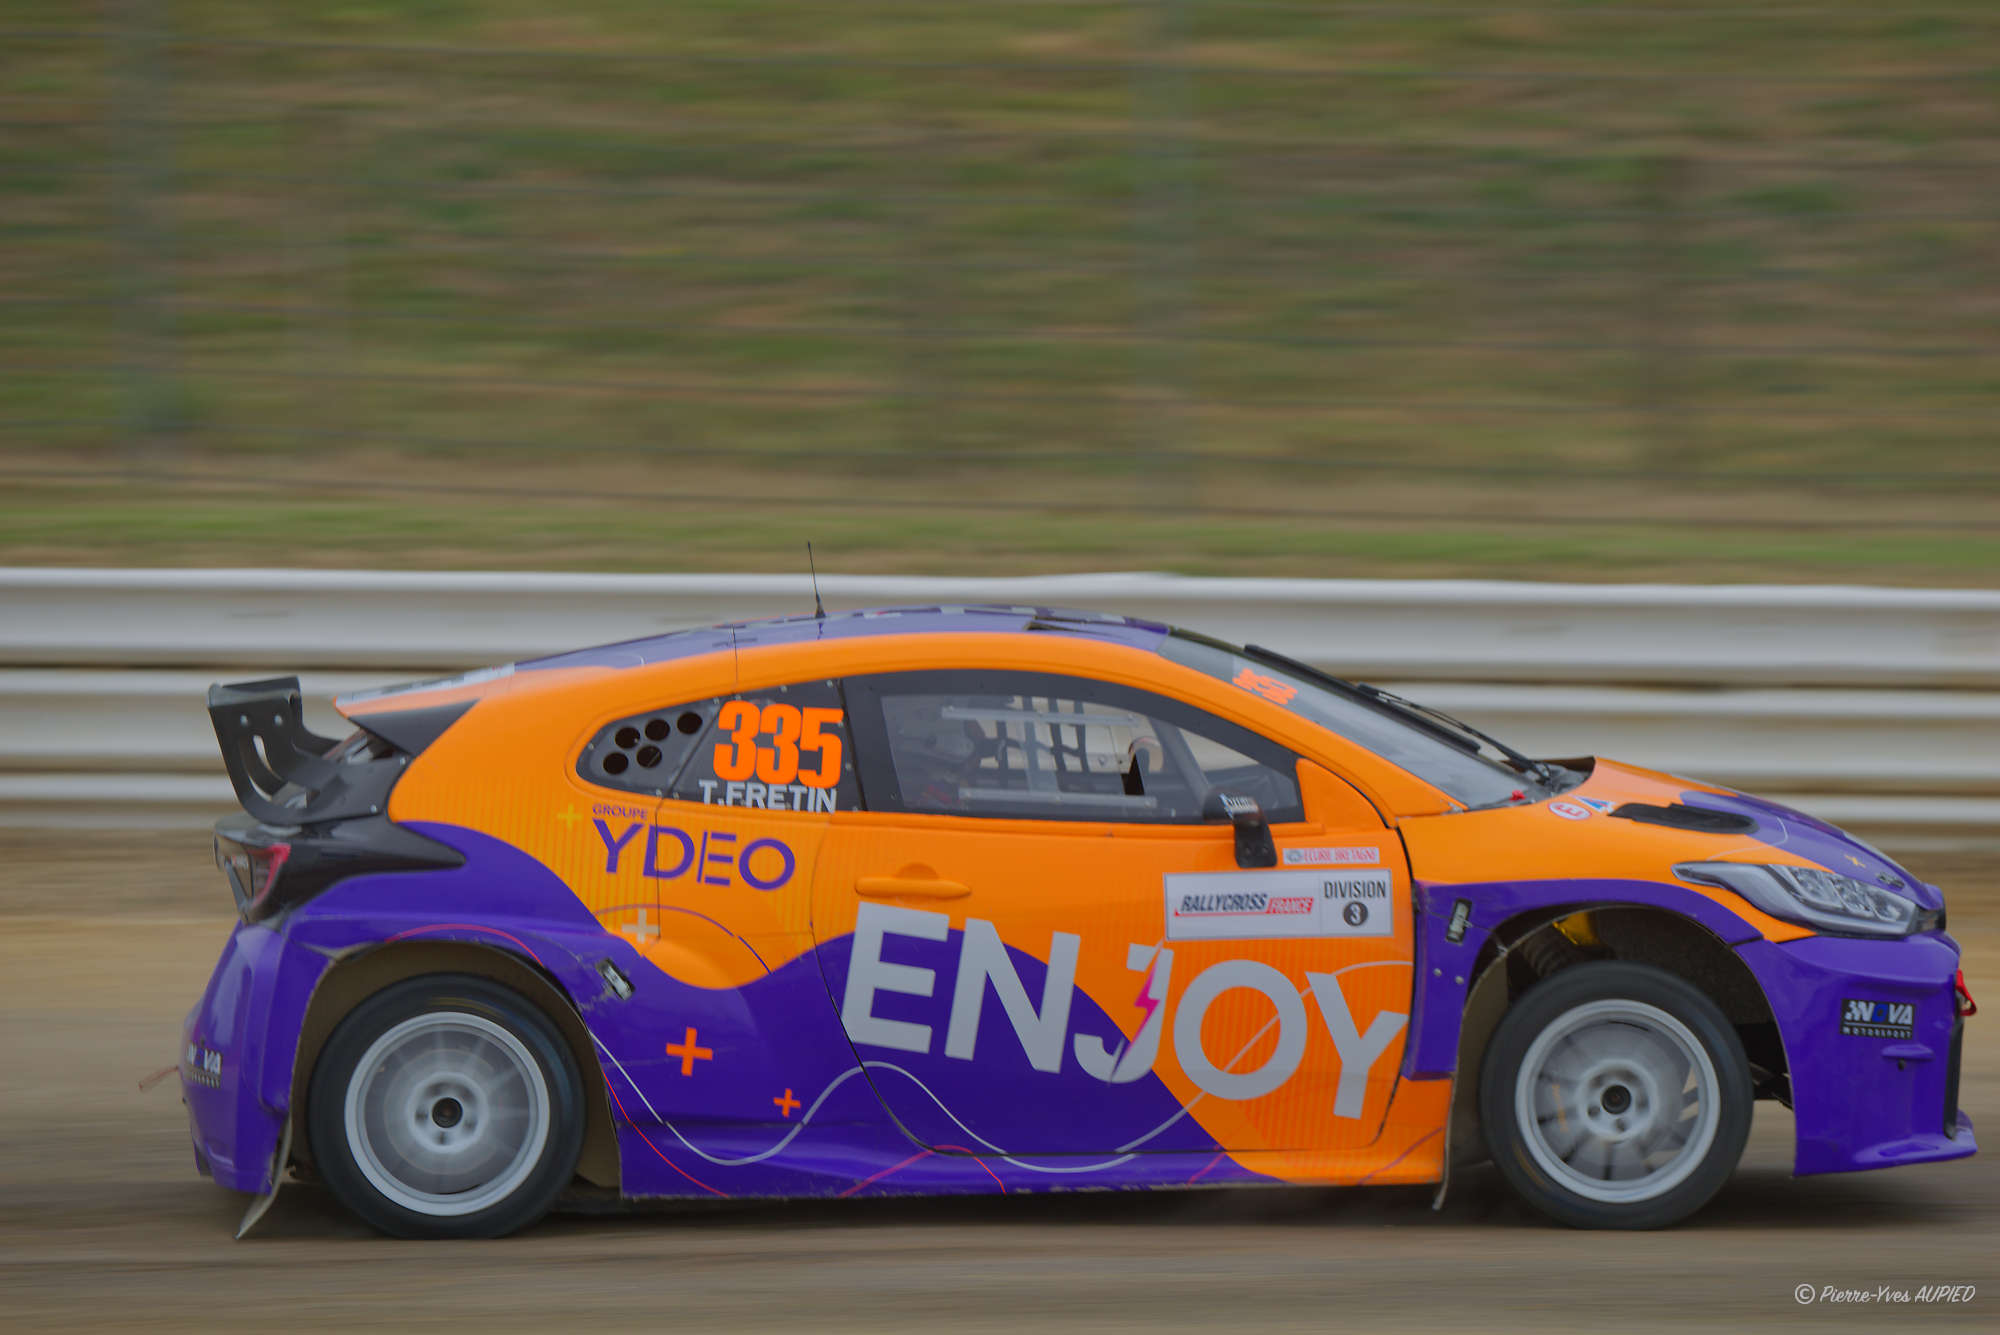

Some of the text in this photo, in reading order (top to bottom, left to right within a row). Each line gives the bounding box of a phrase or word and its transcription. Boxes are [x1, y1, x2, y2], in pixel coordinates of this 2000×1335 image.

[713, 700, 844, 789] 335
[698, 779, 838, 814] T.FRETIN
[592, 803, 648, 819] GROUPE
[592, 818, 795, 891] YDEO
[1323, 881, 1386, 899] DIVISION
[1180, 894, 1313, 914] RALLYCROSS FRANCE
[1348, 903, 1364, 926] 3
[840, 901, 1409, 1120] ENJOY
[1849, 1000, 1913, 1025] NOVA
[1842, 1026, 1912, 1038] MOTORSPORT
